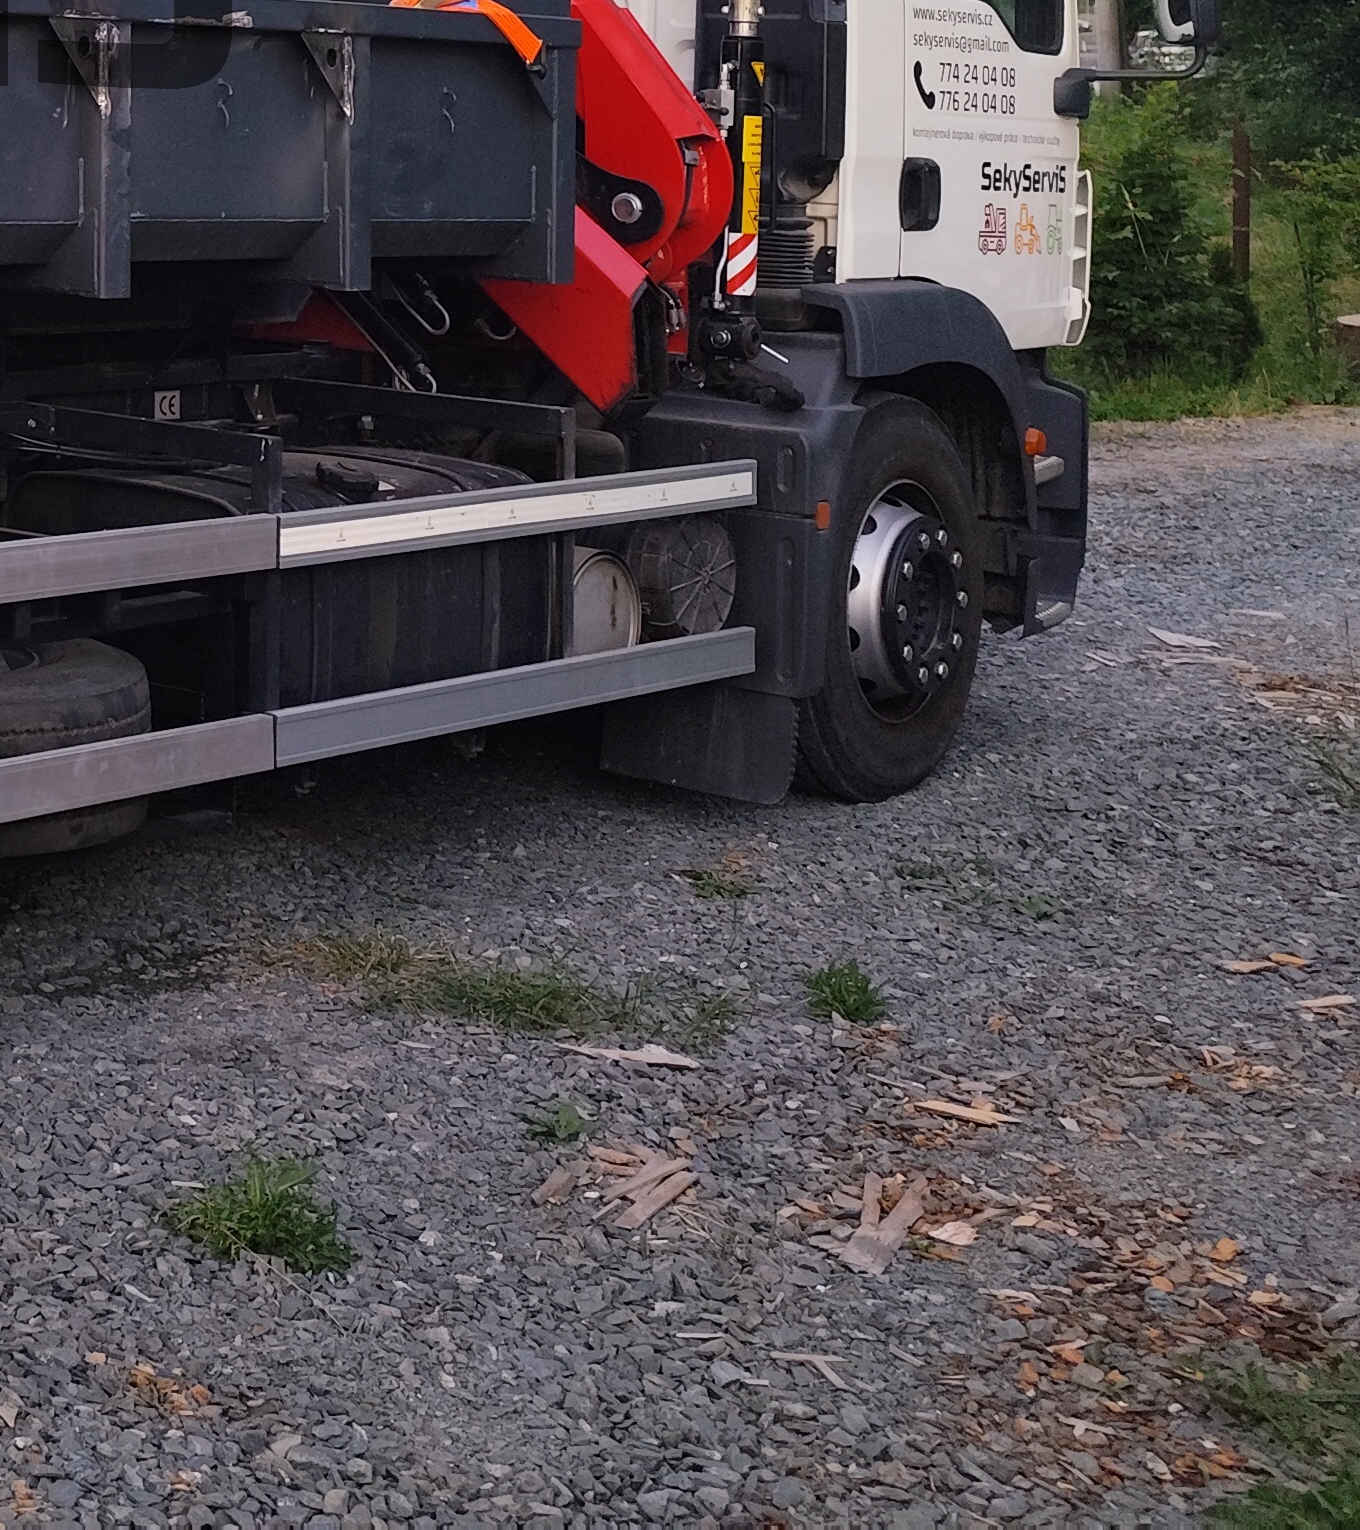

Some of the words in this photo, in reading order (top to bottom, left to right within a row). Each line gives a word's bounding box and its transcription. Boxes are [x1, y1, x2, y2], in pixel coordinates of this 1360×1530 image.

[912, 7, 993, 26] www.sekyservis.cz
[912, 31, 1010, 53] sekyservis@gmail.com
[939, 62, 960, 83] 774
[963, 64, 978, 84] 24
[982, 65, 998, 86] 04
[1000, 66, 1016, 88] 08
[939, 91, 960, 112] 776
[963, 92, 978, 113] 24
[982, 93, 997, 114] 04
[1000, 95, 1016, 115] 08
[980, 161, 1066, 199] SekyServiS
[159, 394, 176, 416] CE
